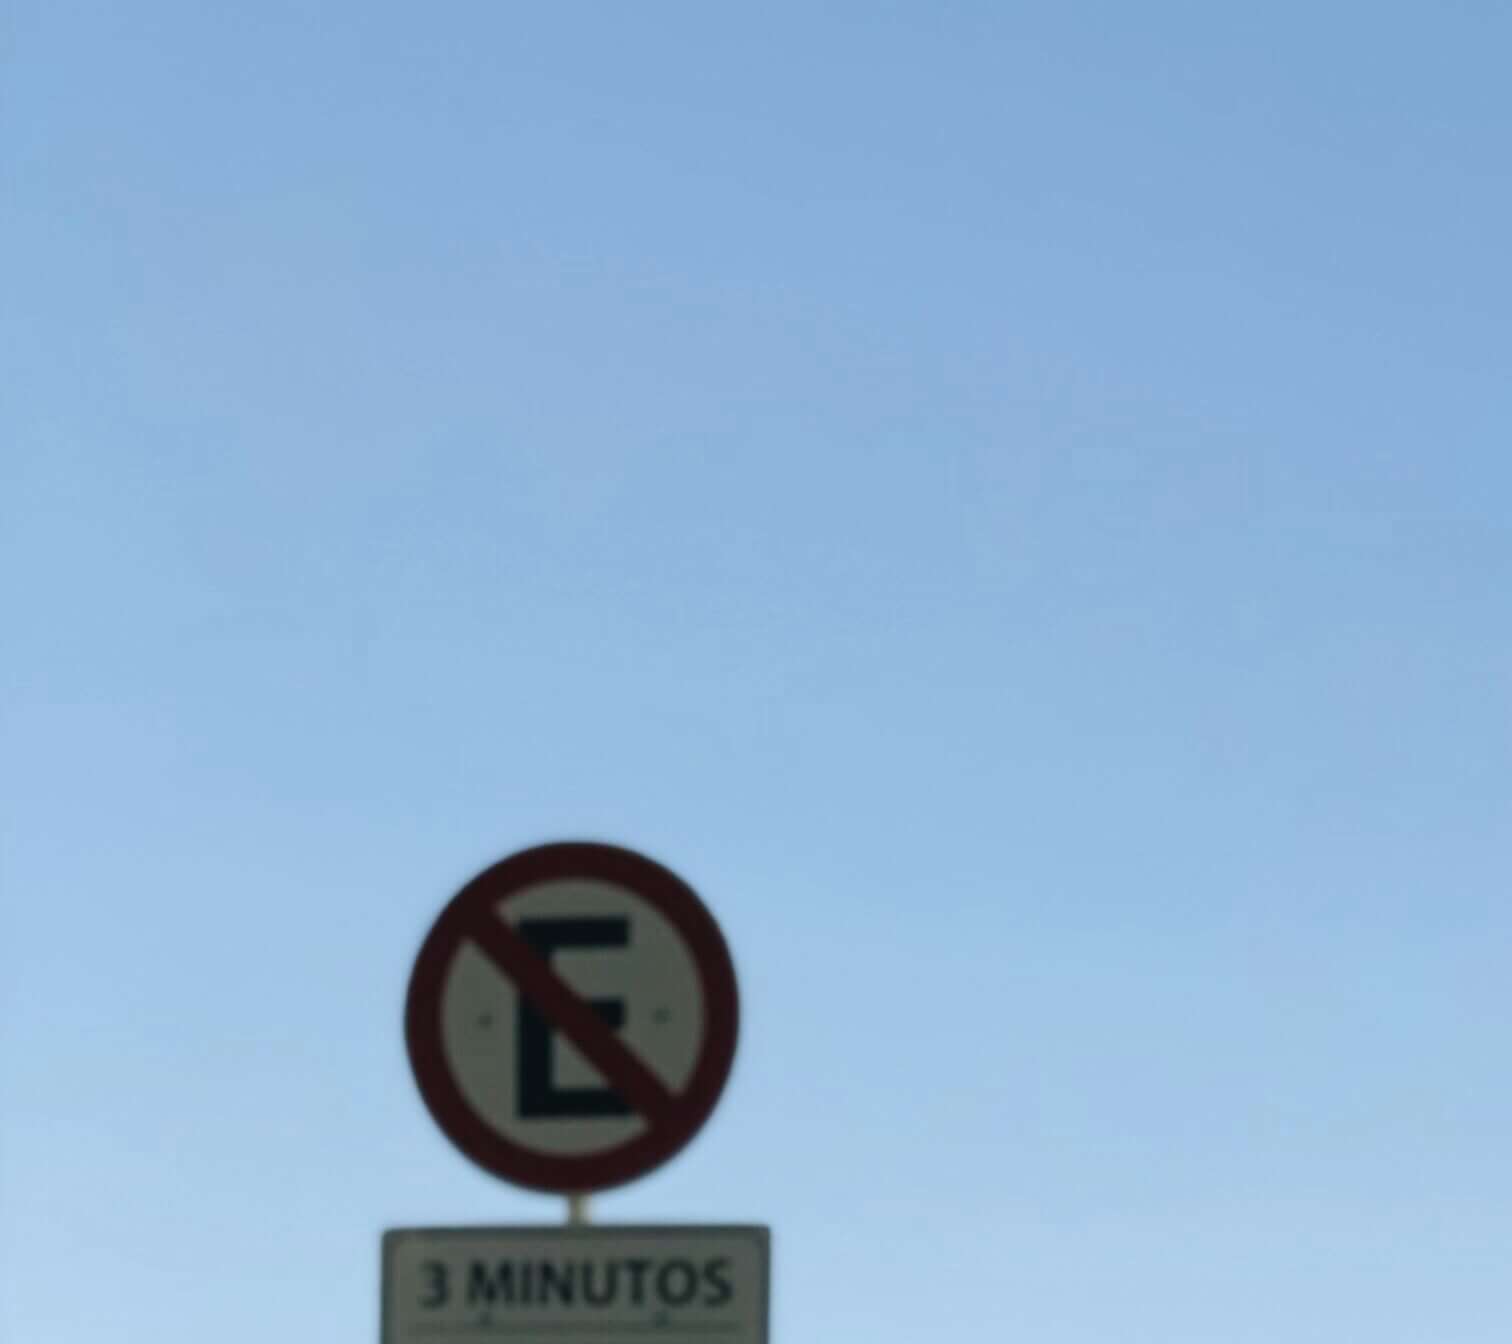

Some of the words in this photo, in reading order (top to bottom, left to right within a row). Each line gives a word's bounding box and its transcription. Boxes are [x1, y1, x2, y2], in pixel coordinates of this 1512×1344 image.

[517, 916, 629, 1119] E
[420, 1259, 450, 1310] 3
[467, 1257, 735, 1309] MINUTOS
